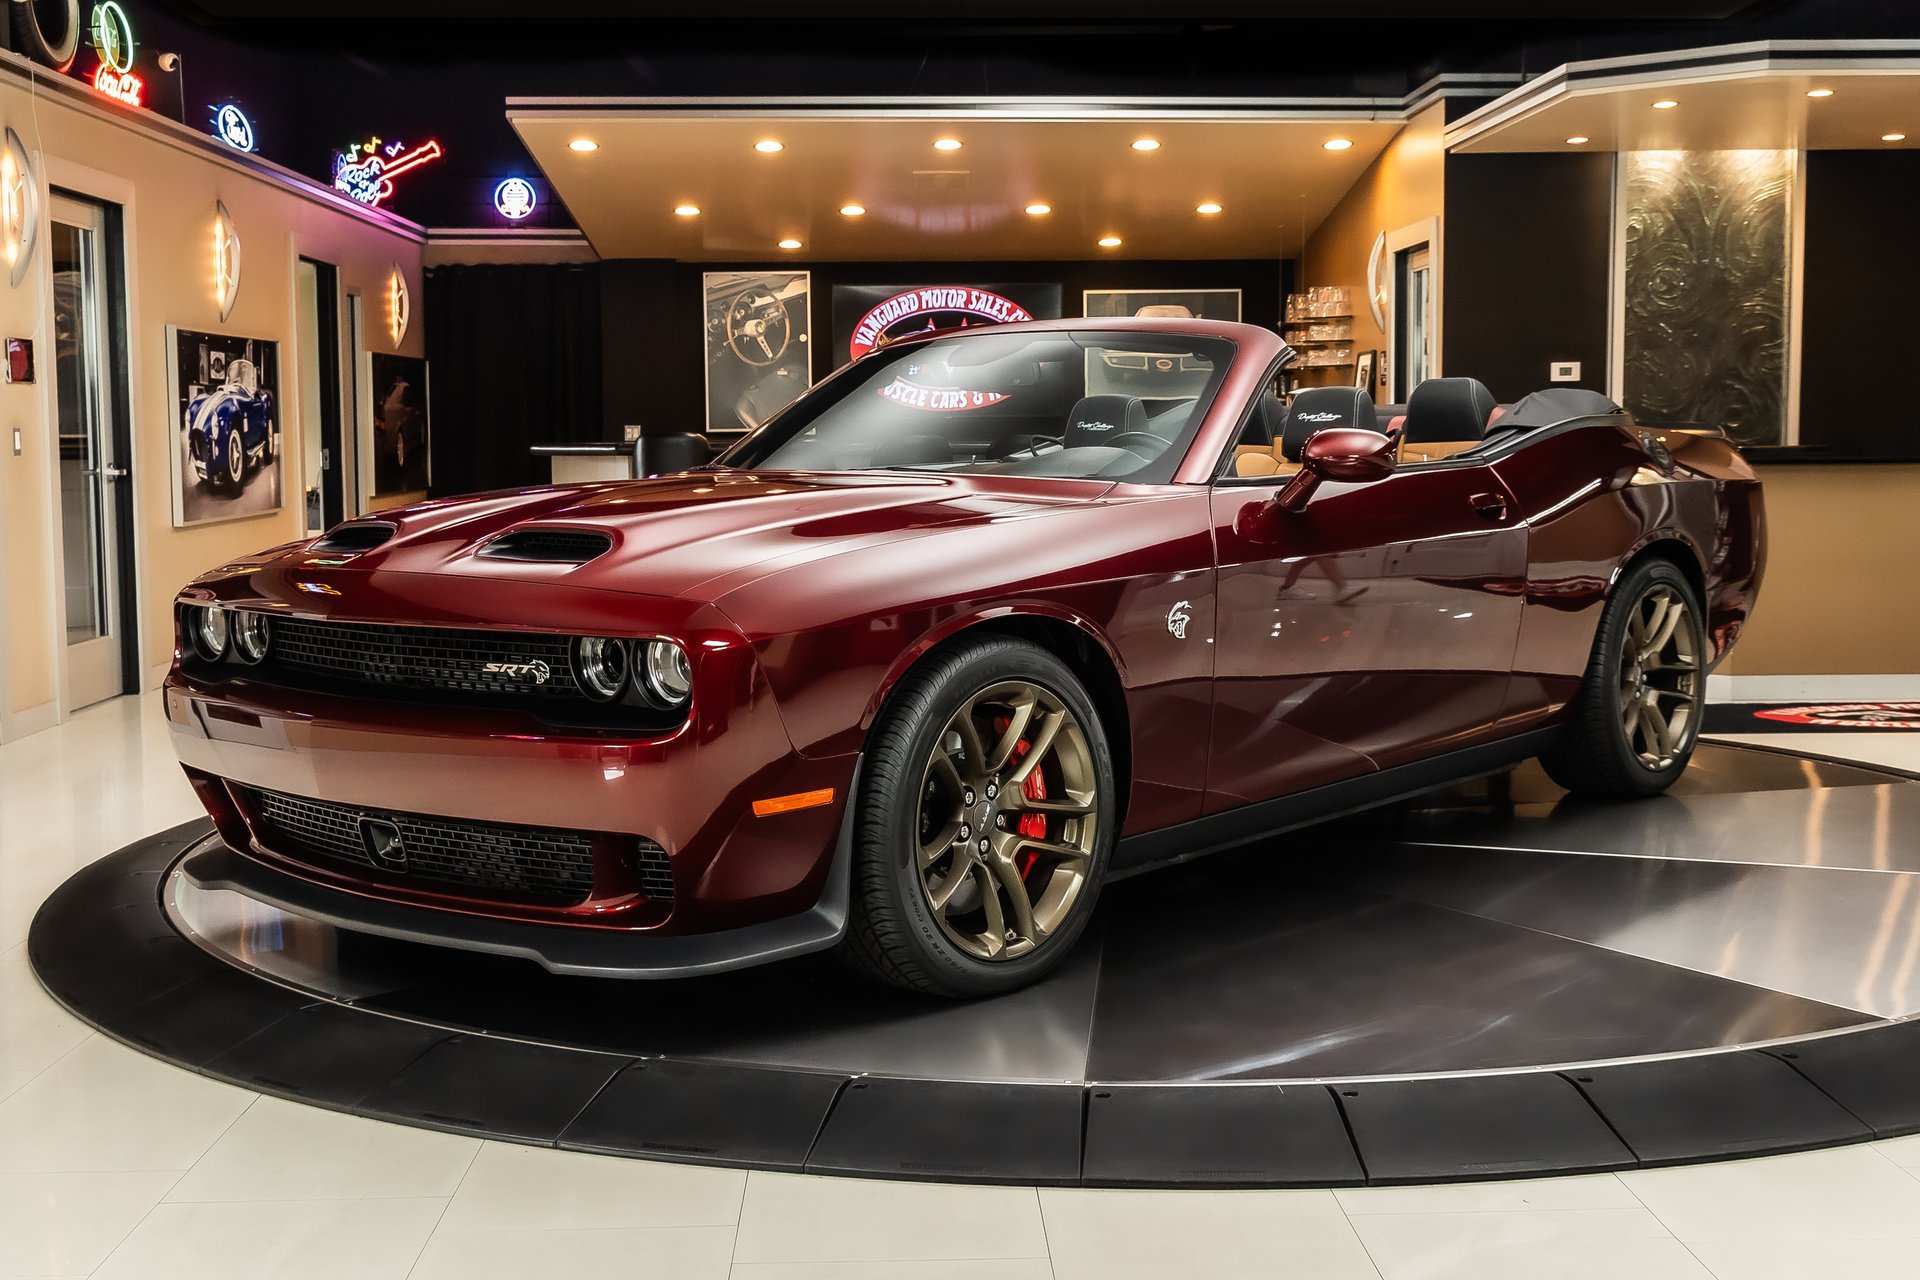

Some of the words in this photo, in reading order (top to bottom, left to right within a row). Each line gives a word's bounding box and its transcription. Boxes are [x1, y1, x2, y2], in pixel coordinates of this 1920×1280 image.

[342, 159, 381, 184] Rock
[855, 294, 919, 346] VANGUARD
[920, 289, 967, 310] MOTOR
[968, 291, 1031, 322] SALES.C
[884, 381, 928, 407] USCLE
[930, 390, 967, 408] CARS
[482, 662, 536, 677] SRT
